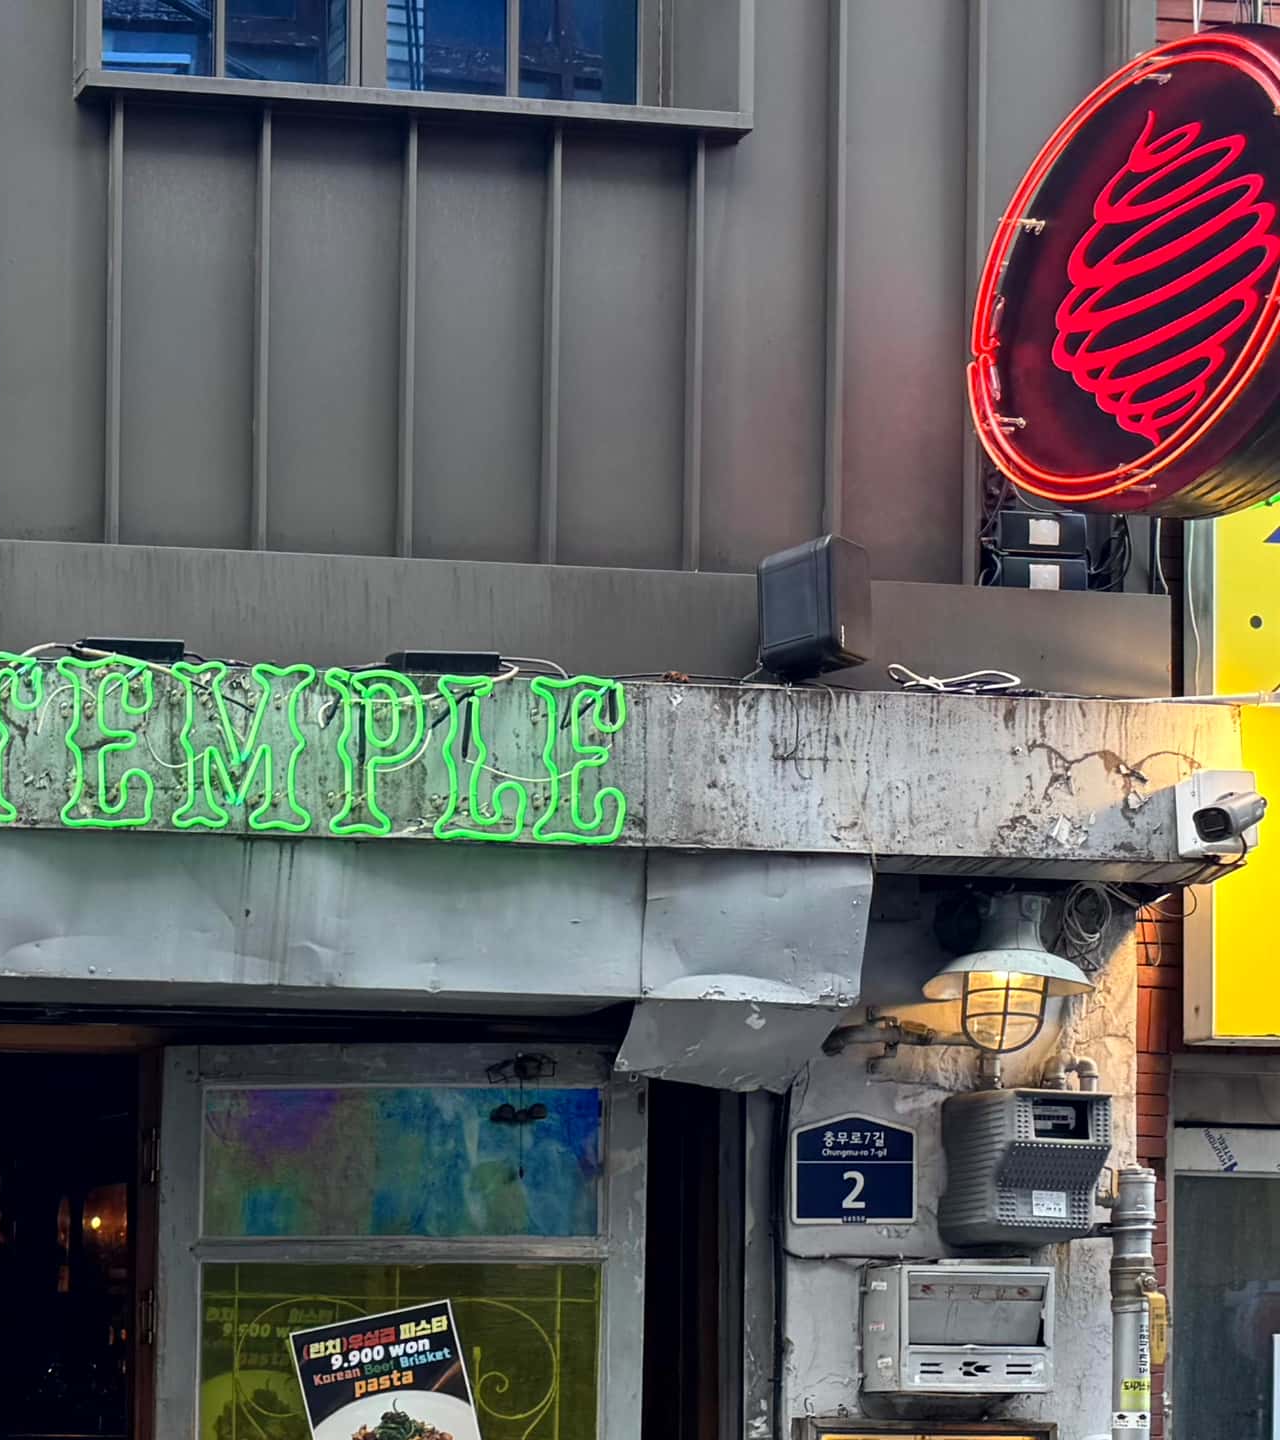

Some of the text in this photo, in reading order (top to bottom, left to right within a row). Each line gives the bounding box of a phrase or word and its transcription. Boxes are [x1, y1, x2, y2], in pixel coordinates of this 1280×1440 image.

[823, 1130, 885, 1147] 충무로7길
[821, 1148, 869, 1158] Chungmu-ro
[842, 1170, 866, 1209] 2
[399, 1315, 449, 1340] 파스타
[313, 1367, 361, 1386] Korean
[399, 1347, 452, 1368] Brisket
[330, 1338, 431, 1370] 9.900 won
[354, 1370, 414, 1398] pasta
